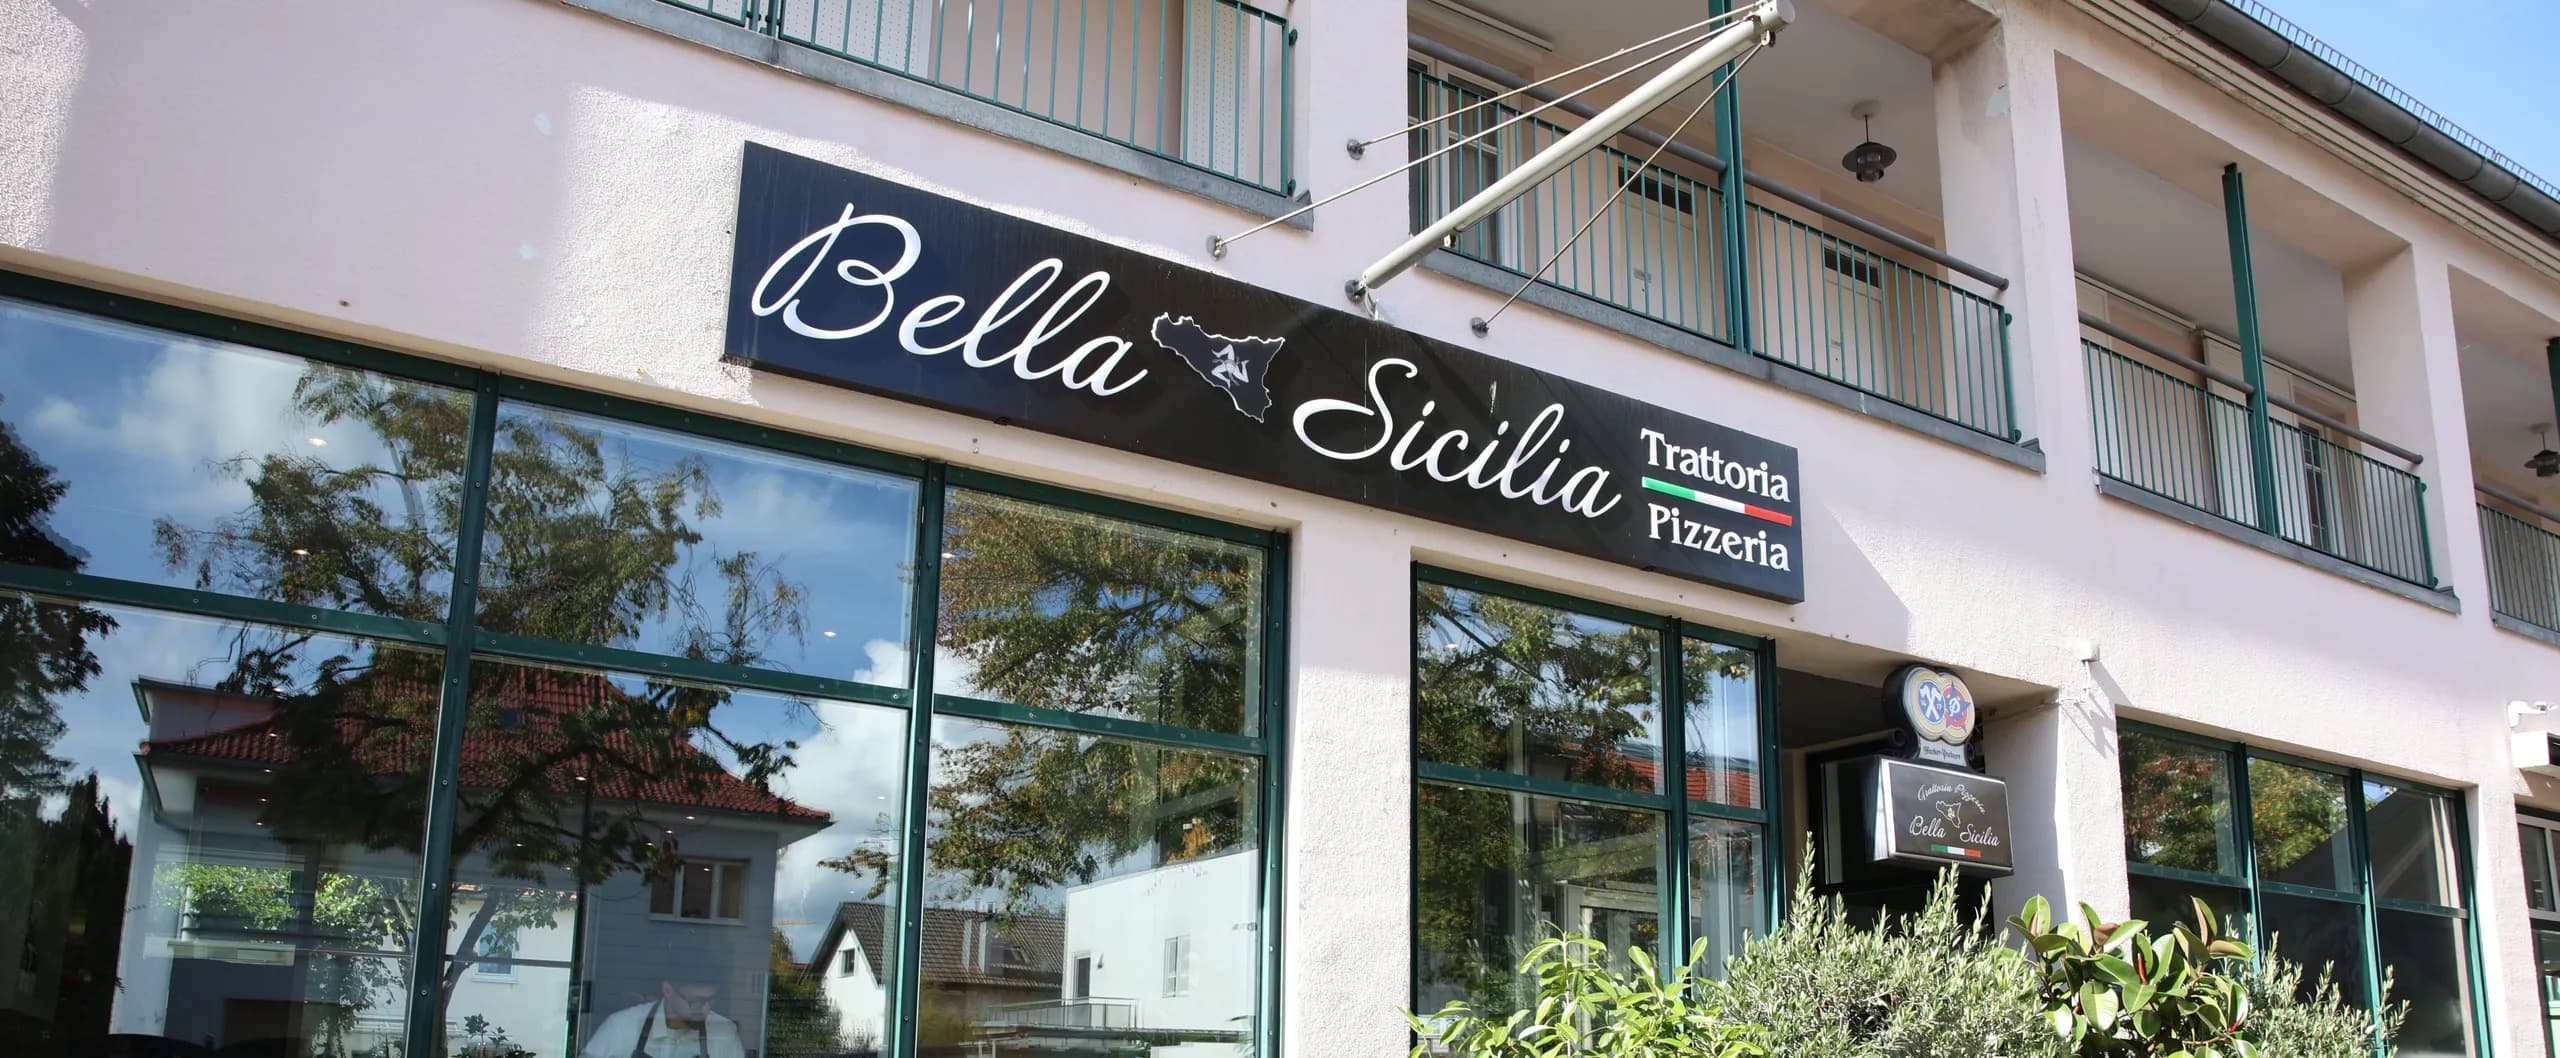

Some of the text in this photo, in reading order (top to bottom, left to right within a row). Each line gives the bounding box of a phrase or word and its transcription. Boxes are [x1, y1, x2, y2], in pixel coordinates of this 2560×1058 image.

[752, 203, 1622, 518] Bella Sicilia
[1640, 427, 1791, 503] Trattoria
[1648, 503, 1791, 572] Pizzeria
[1909, 815, 2000, 847] Bella Sicilia
[1917, 783, 1986, 815] Trattoria Pizzeria
